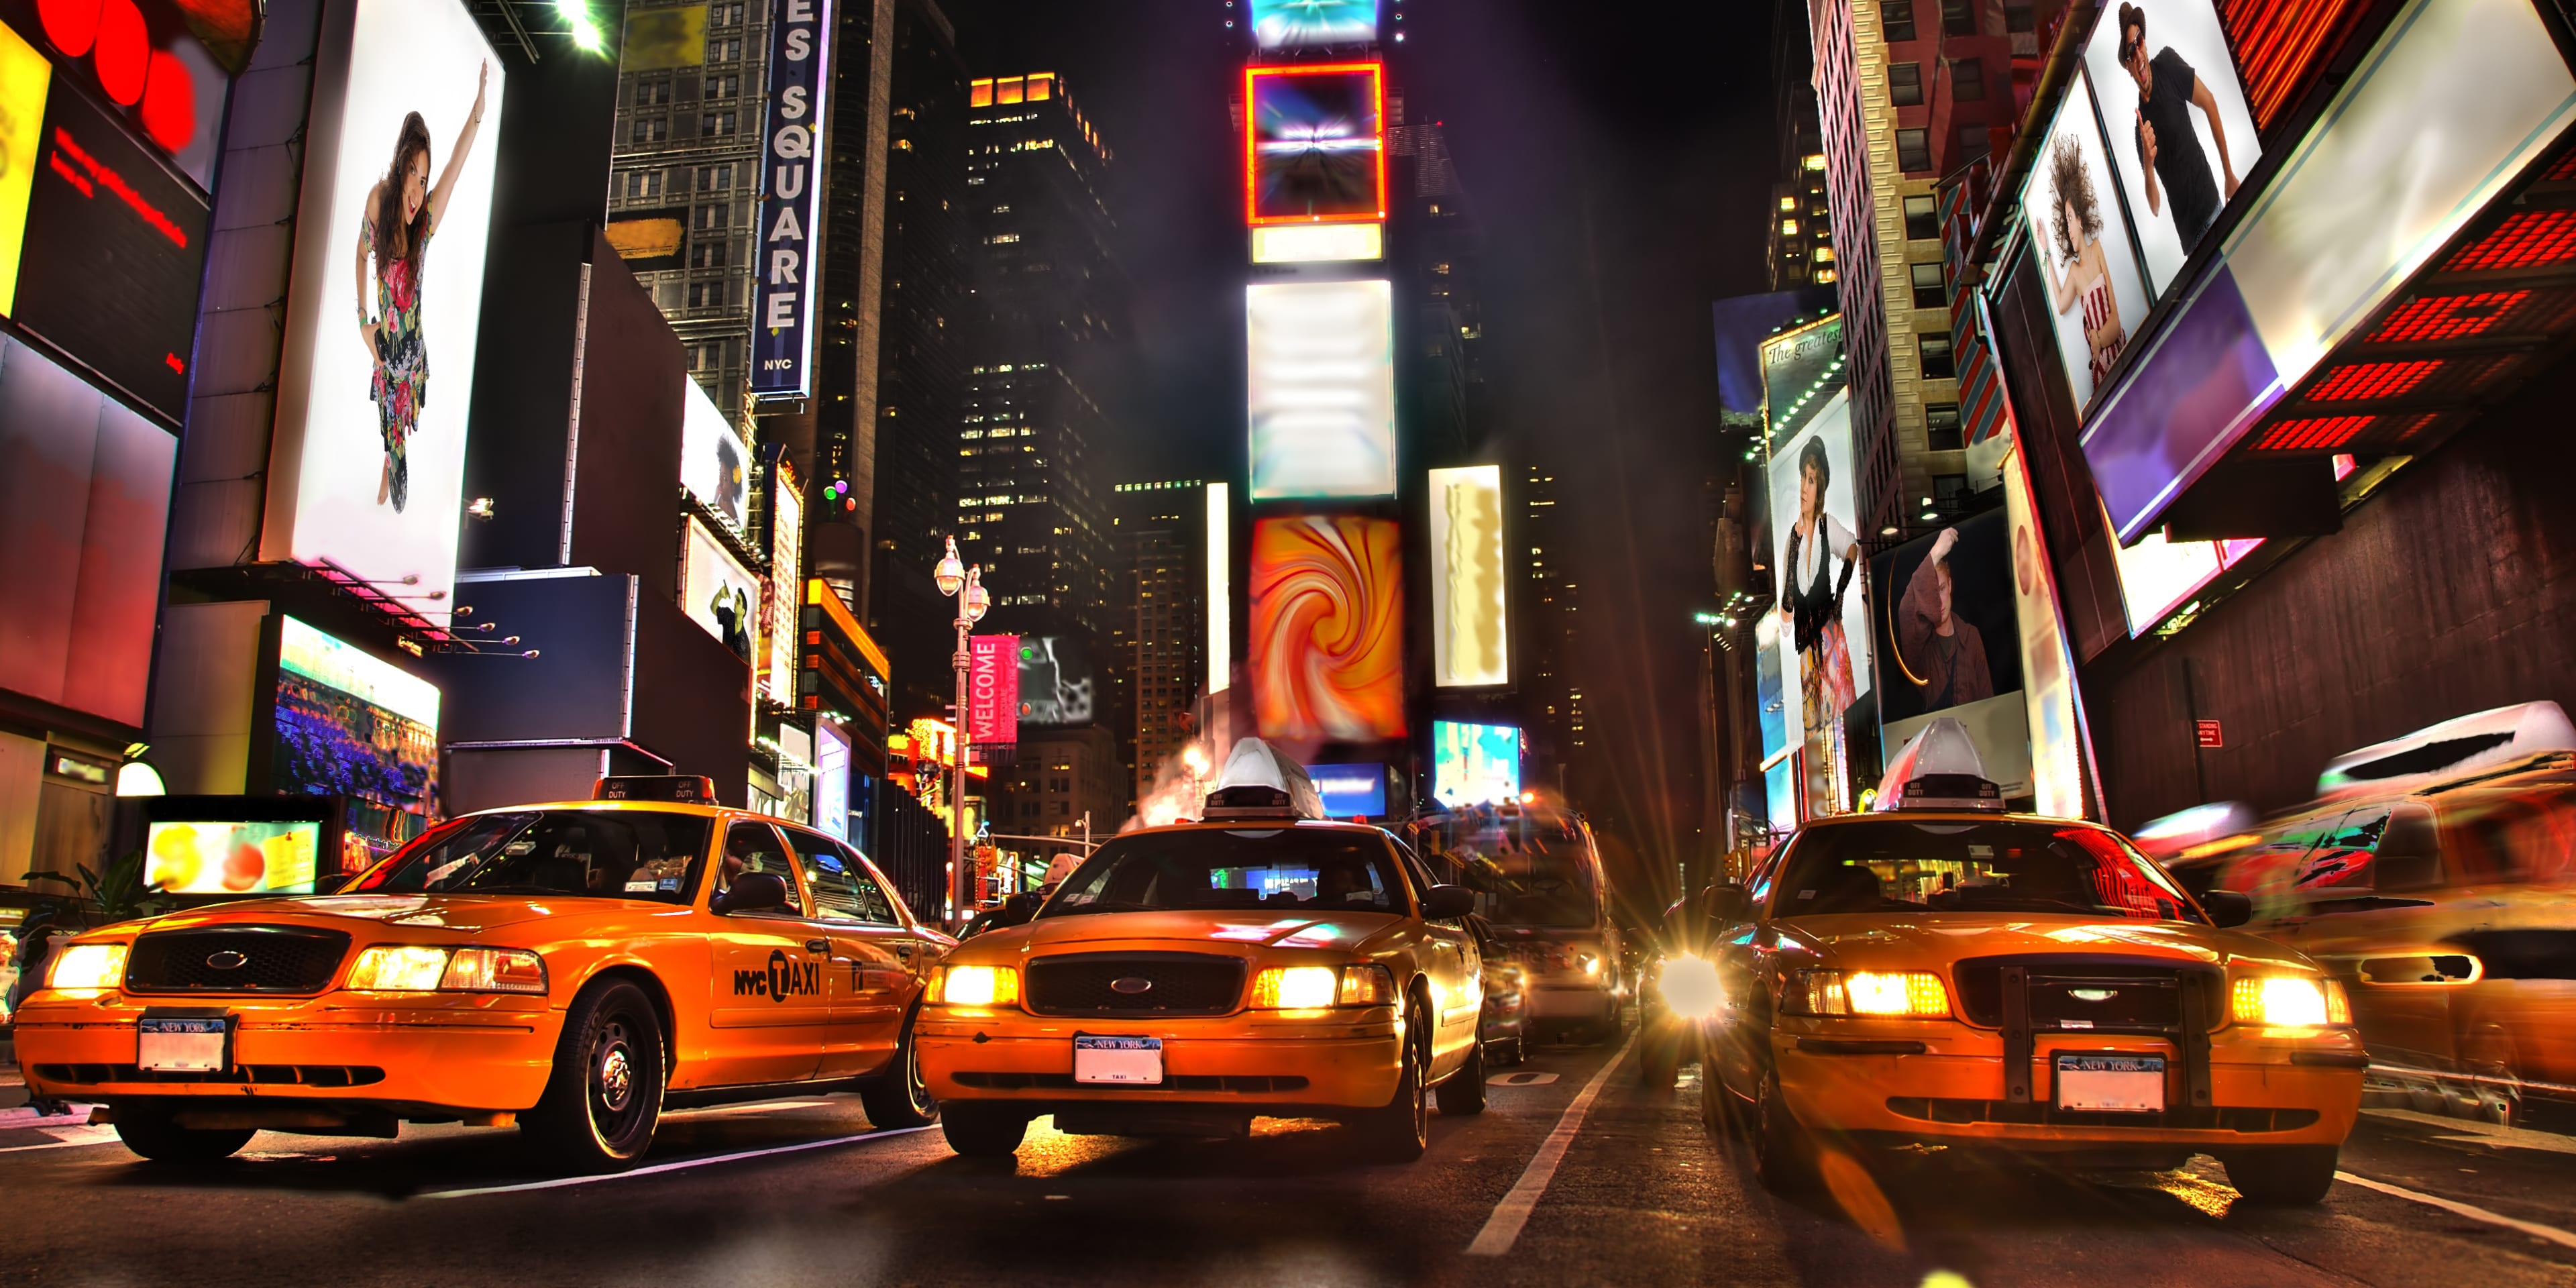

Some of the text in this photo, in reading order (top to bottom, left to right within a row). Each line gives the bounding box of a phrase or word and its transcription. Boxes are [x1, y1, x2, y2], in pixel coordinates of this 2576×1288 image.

[767, 86, 811, 328] SQUARE
[1769, 343, 1790, 364] The
[764, 359, 792, 370] NYC
[975, 643, 996, 740] WELCOME
[676, 790, 694, 798] DUTY
[734, 960, 819, 996] NYC TAXI
[161, 1022, 207, 1032] NEW YORK
[1096, 1040, 1141, 1049] NEW YORK
[2084, 1061, 2138, 1071] NEW YORK
